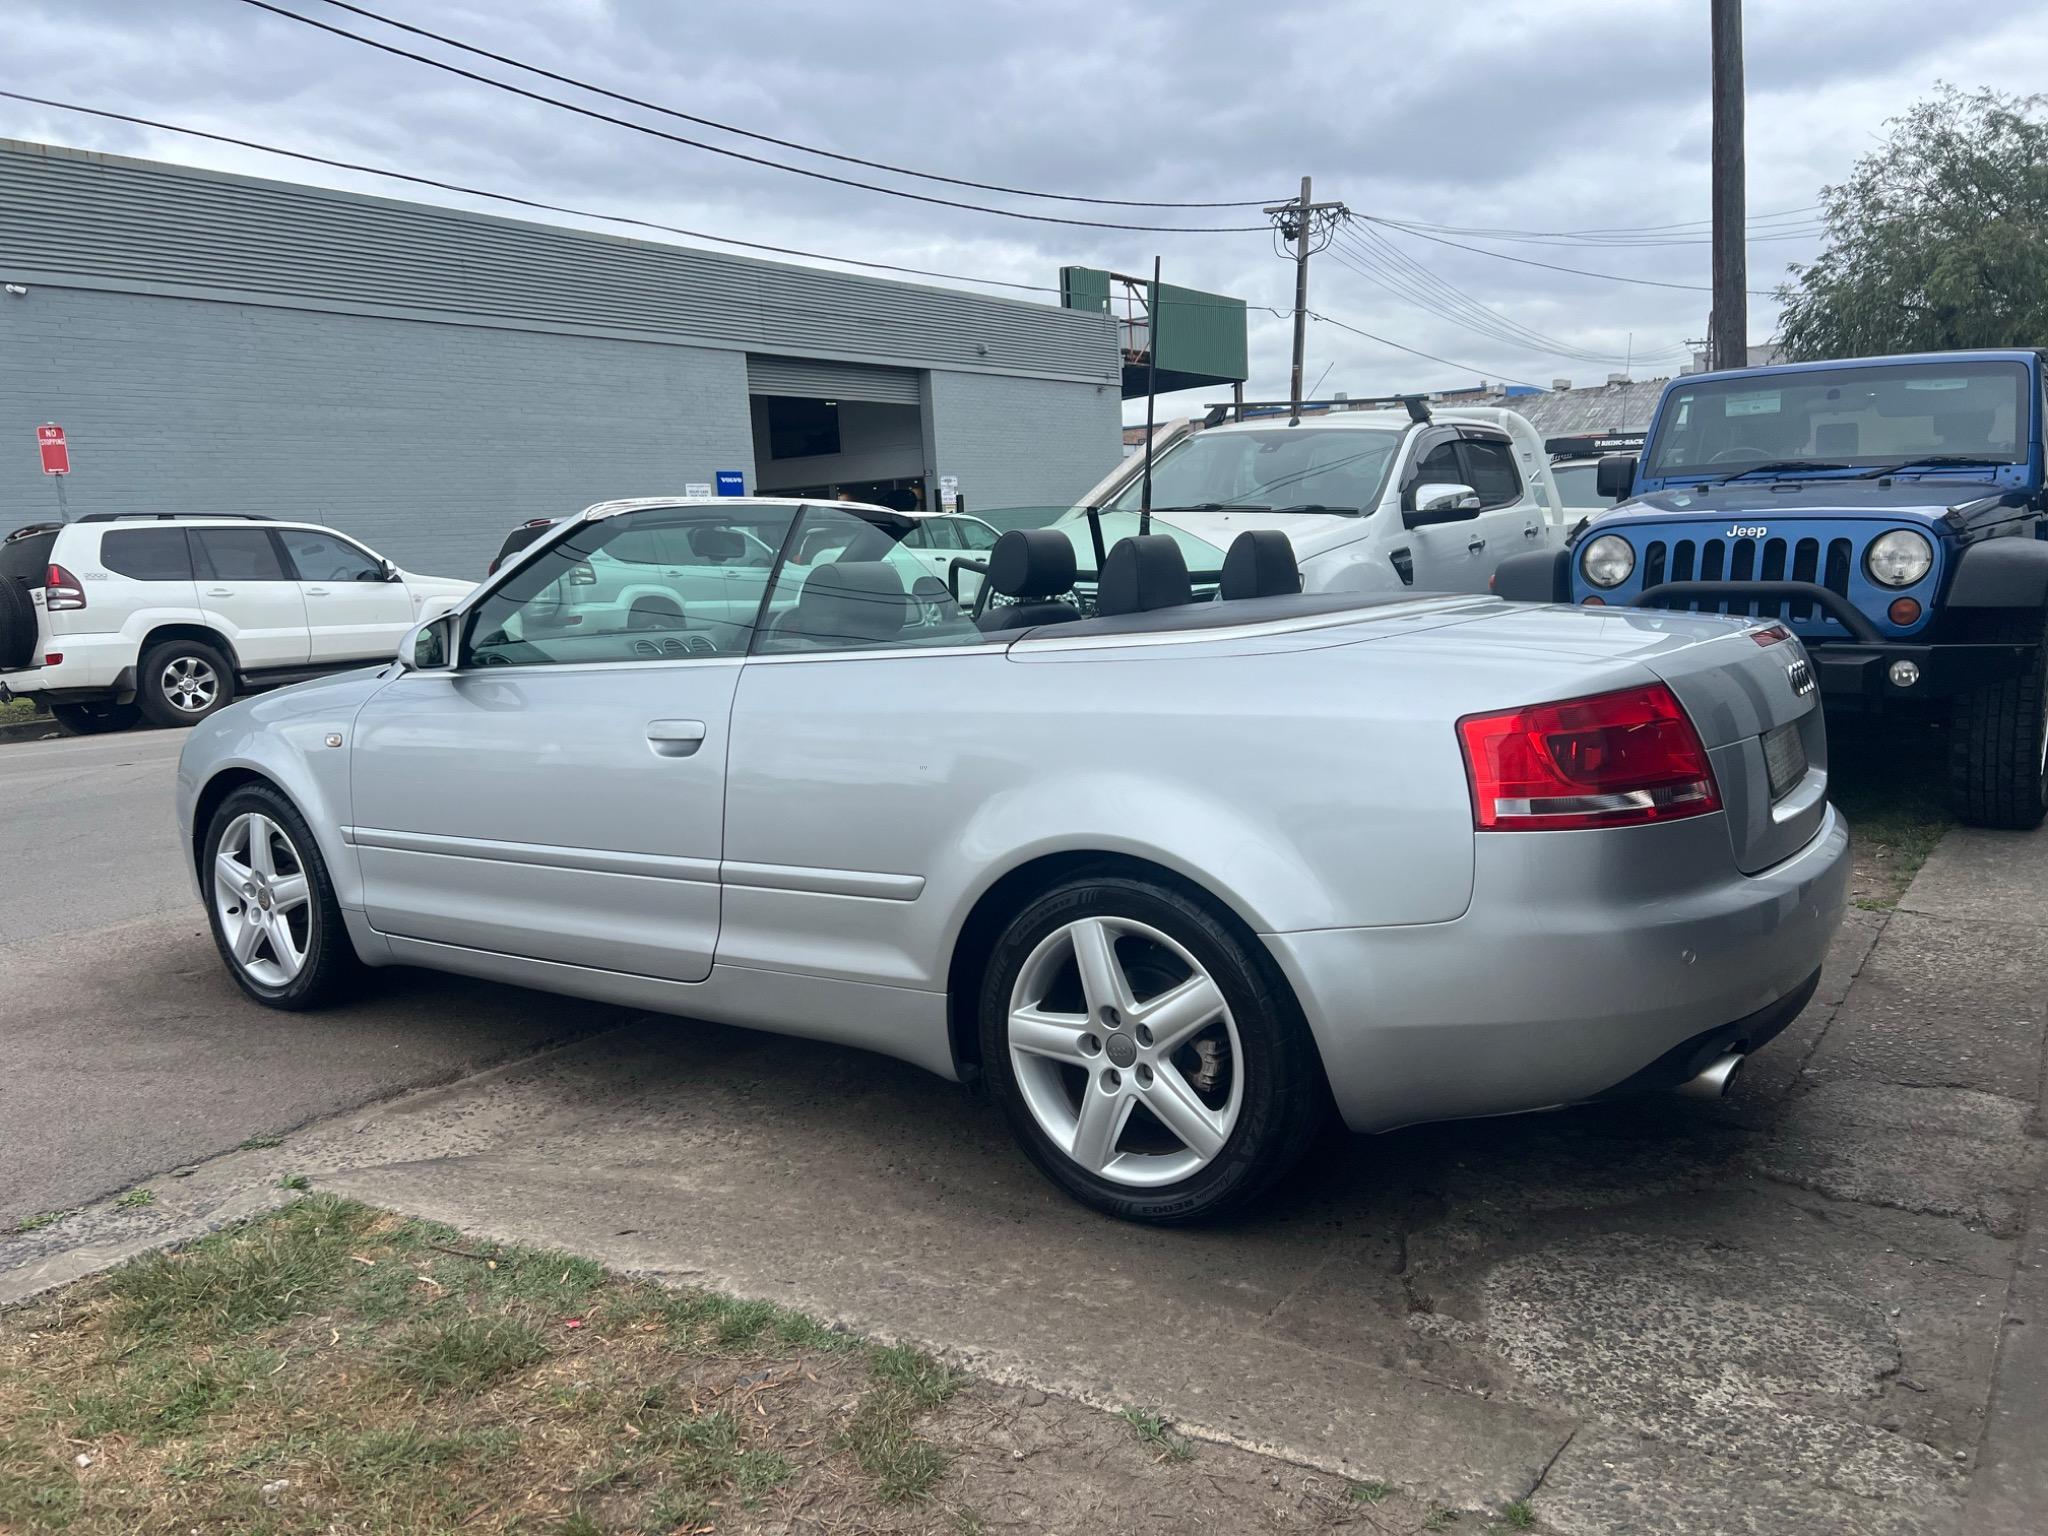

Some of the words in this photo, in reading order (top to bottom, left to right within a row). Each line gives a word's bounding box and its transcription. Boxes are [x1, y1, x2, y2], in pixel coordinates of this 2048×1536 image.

[45, 429, 57, 438] NO
[40, 438, 65, 446] STOPPING
[1726, 524, 1767, 539] Jeep
